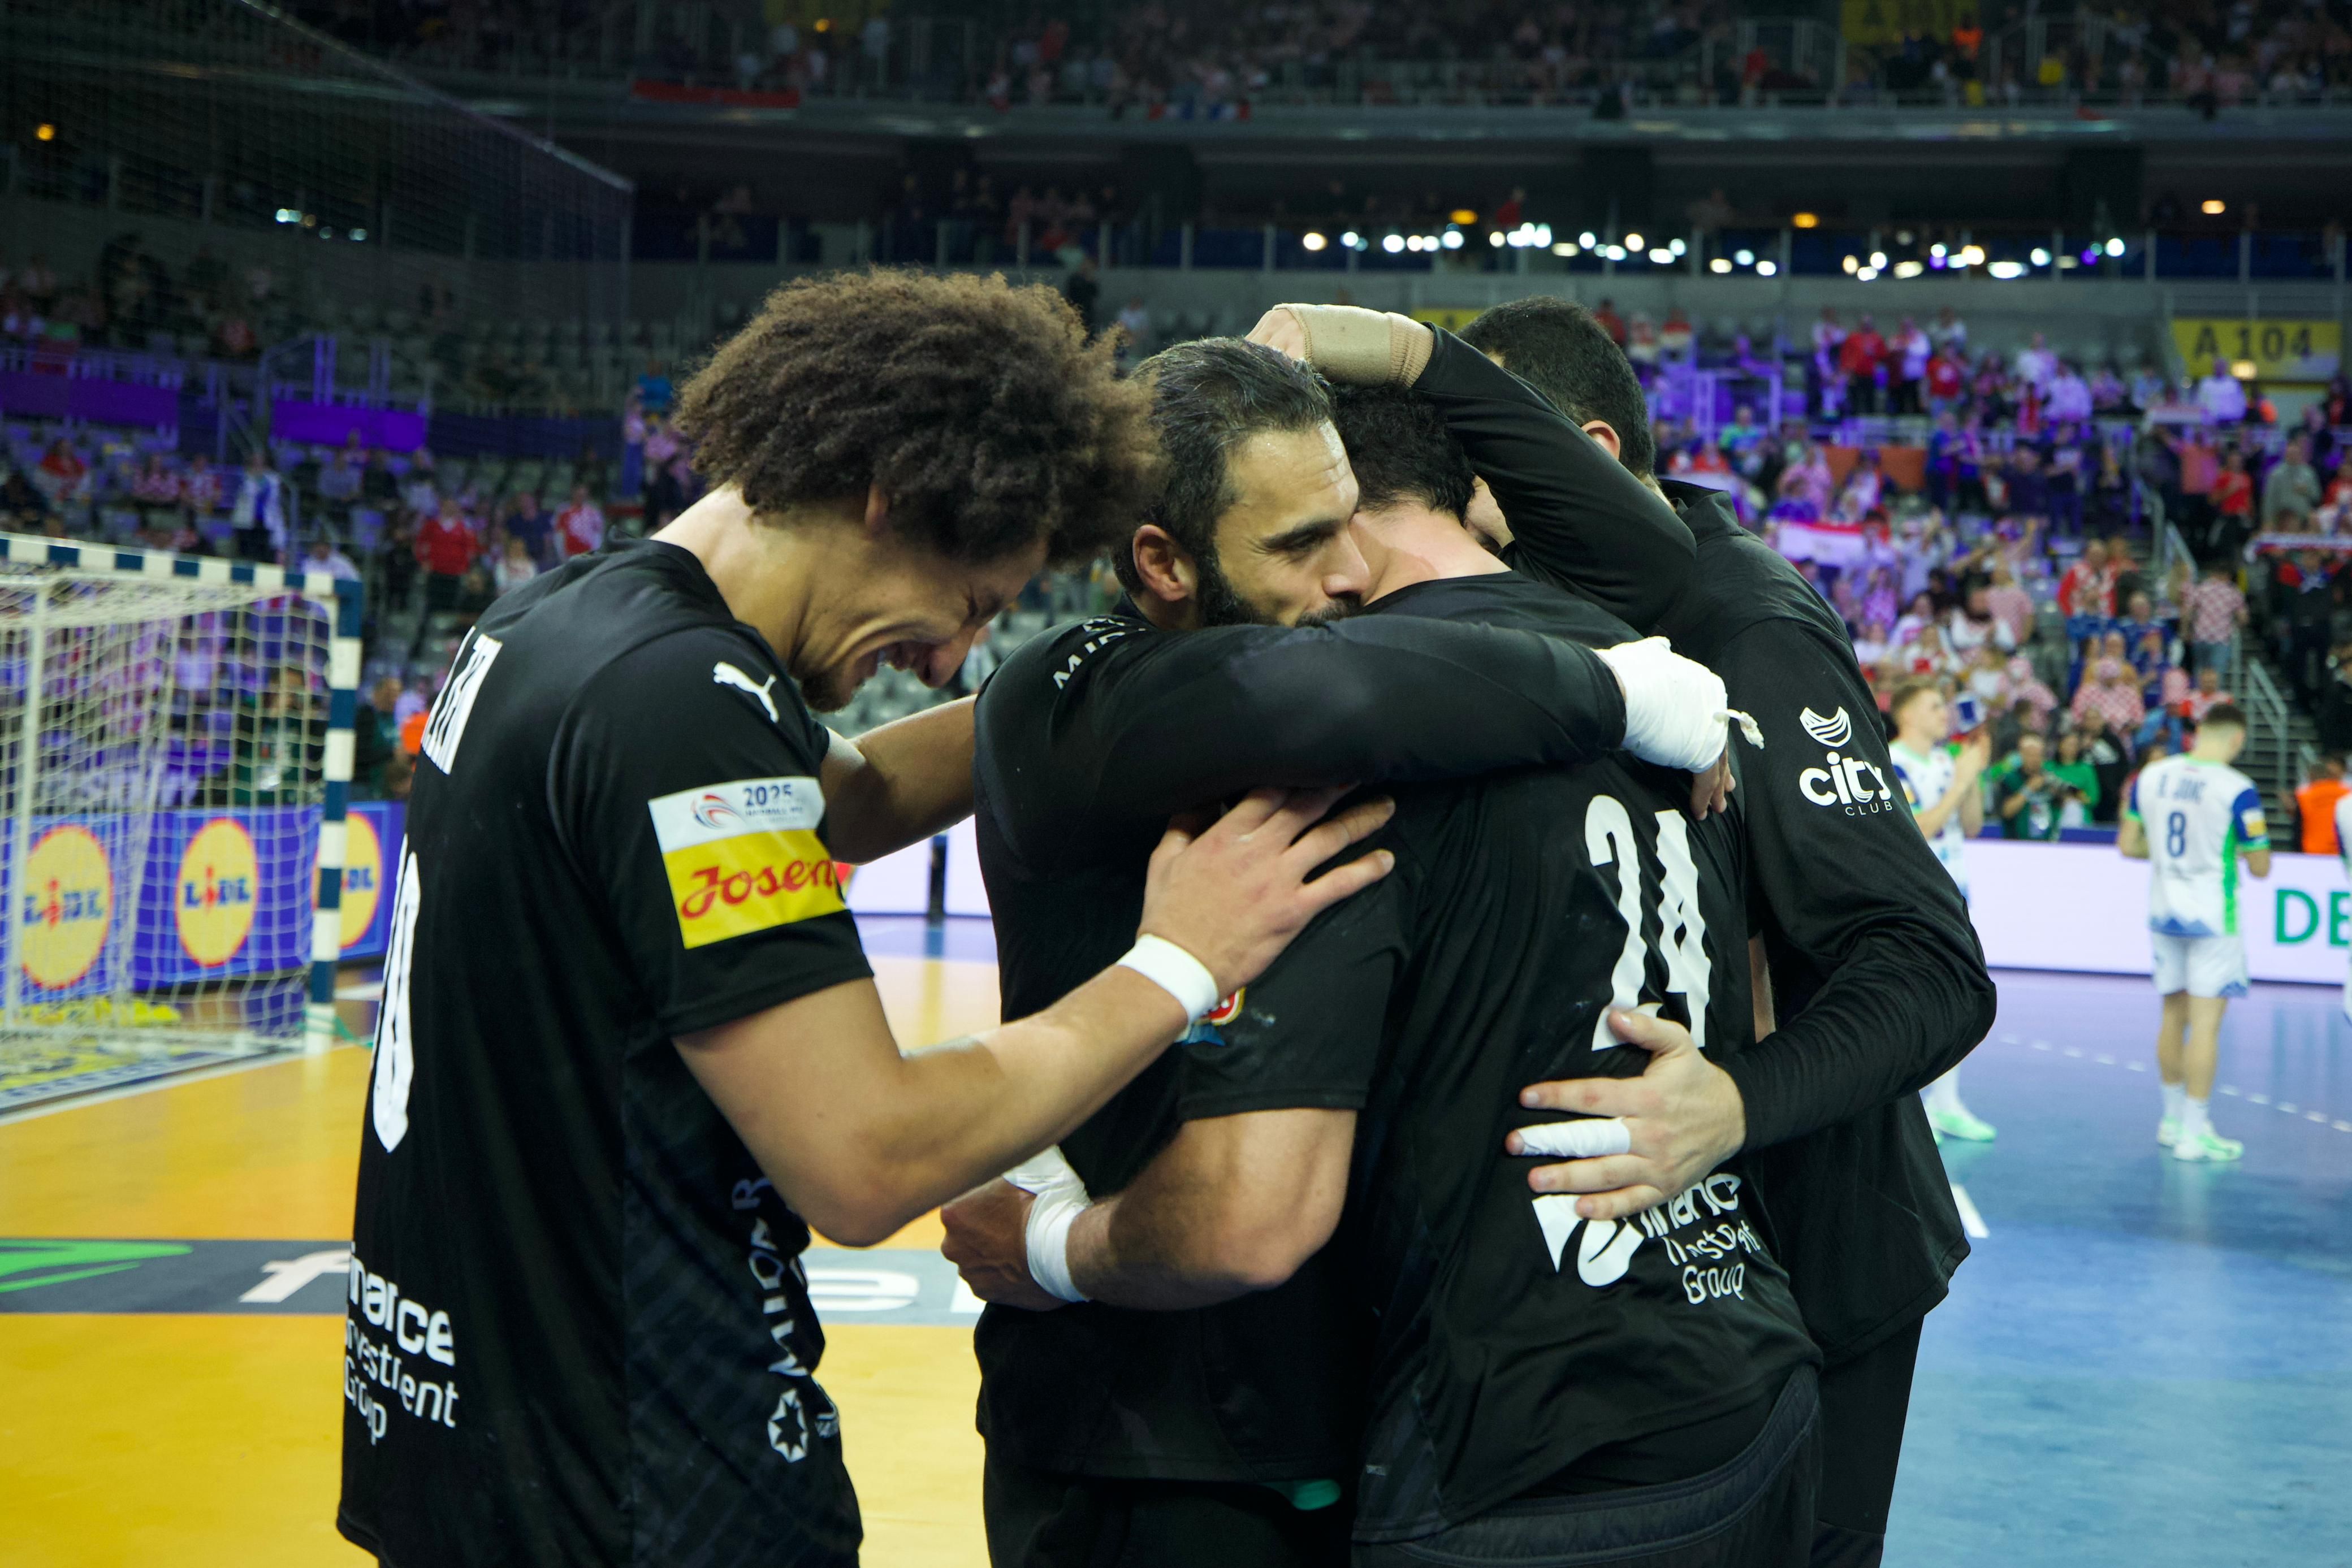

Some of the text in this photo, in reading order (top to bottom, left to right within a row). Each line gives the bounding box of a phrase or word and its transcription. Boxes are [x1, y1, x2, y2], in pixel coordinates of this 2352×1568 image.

[2195, 326, 2314, 362] A 104
[1799, 751, 1891, 807] city
[1845, 800, 1893, 817] CLUB
[2167, 810, 2186, 858] 8
[1584, 794, 1712, 1052] 24
[1682, 1262, 1745, 1305] Group
